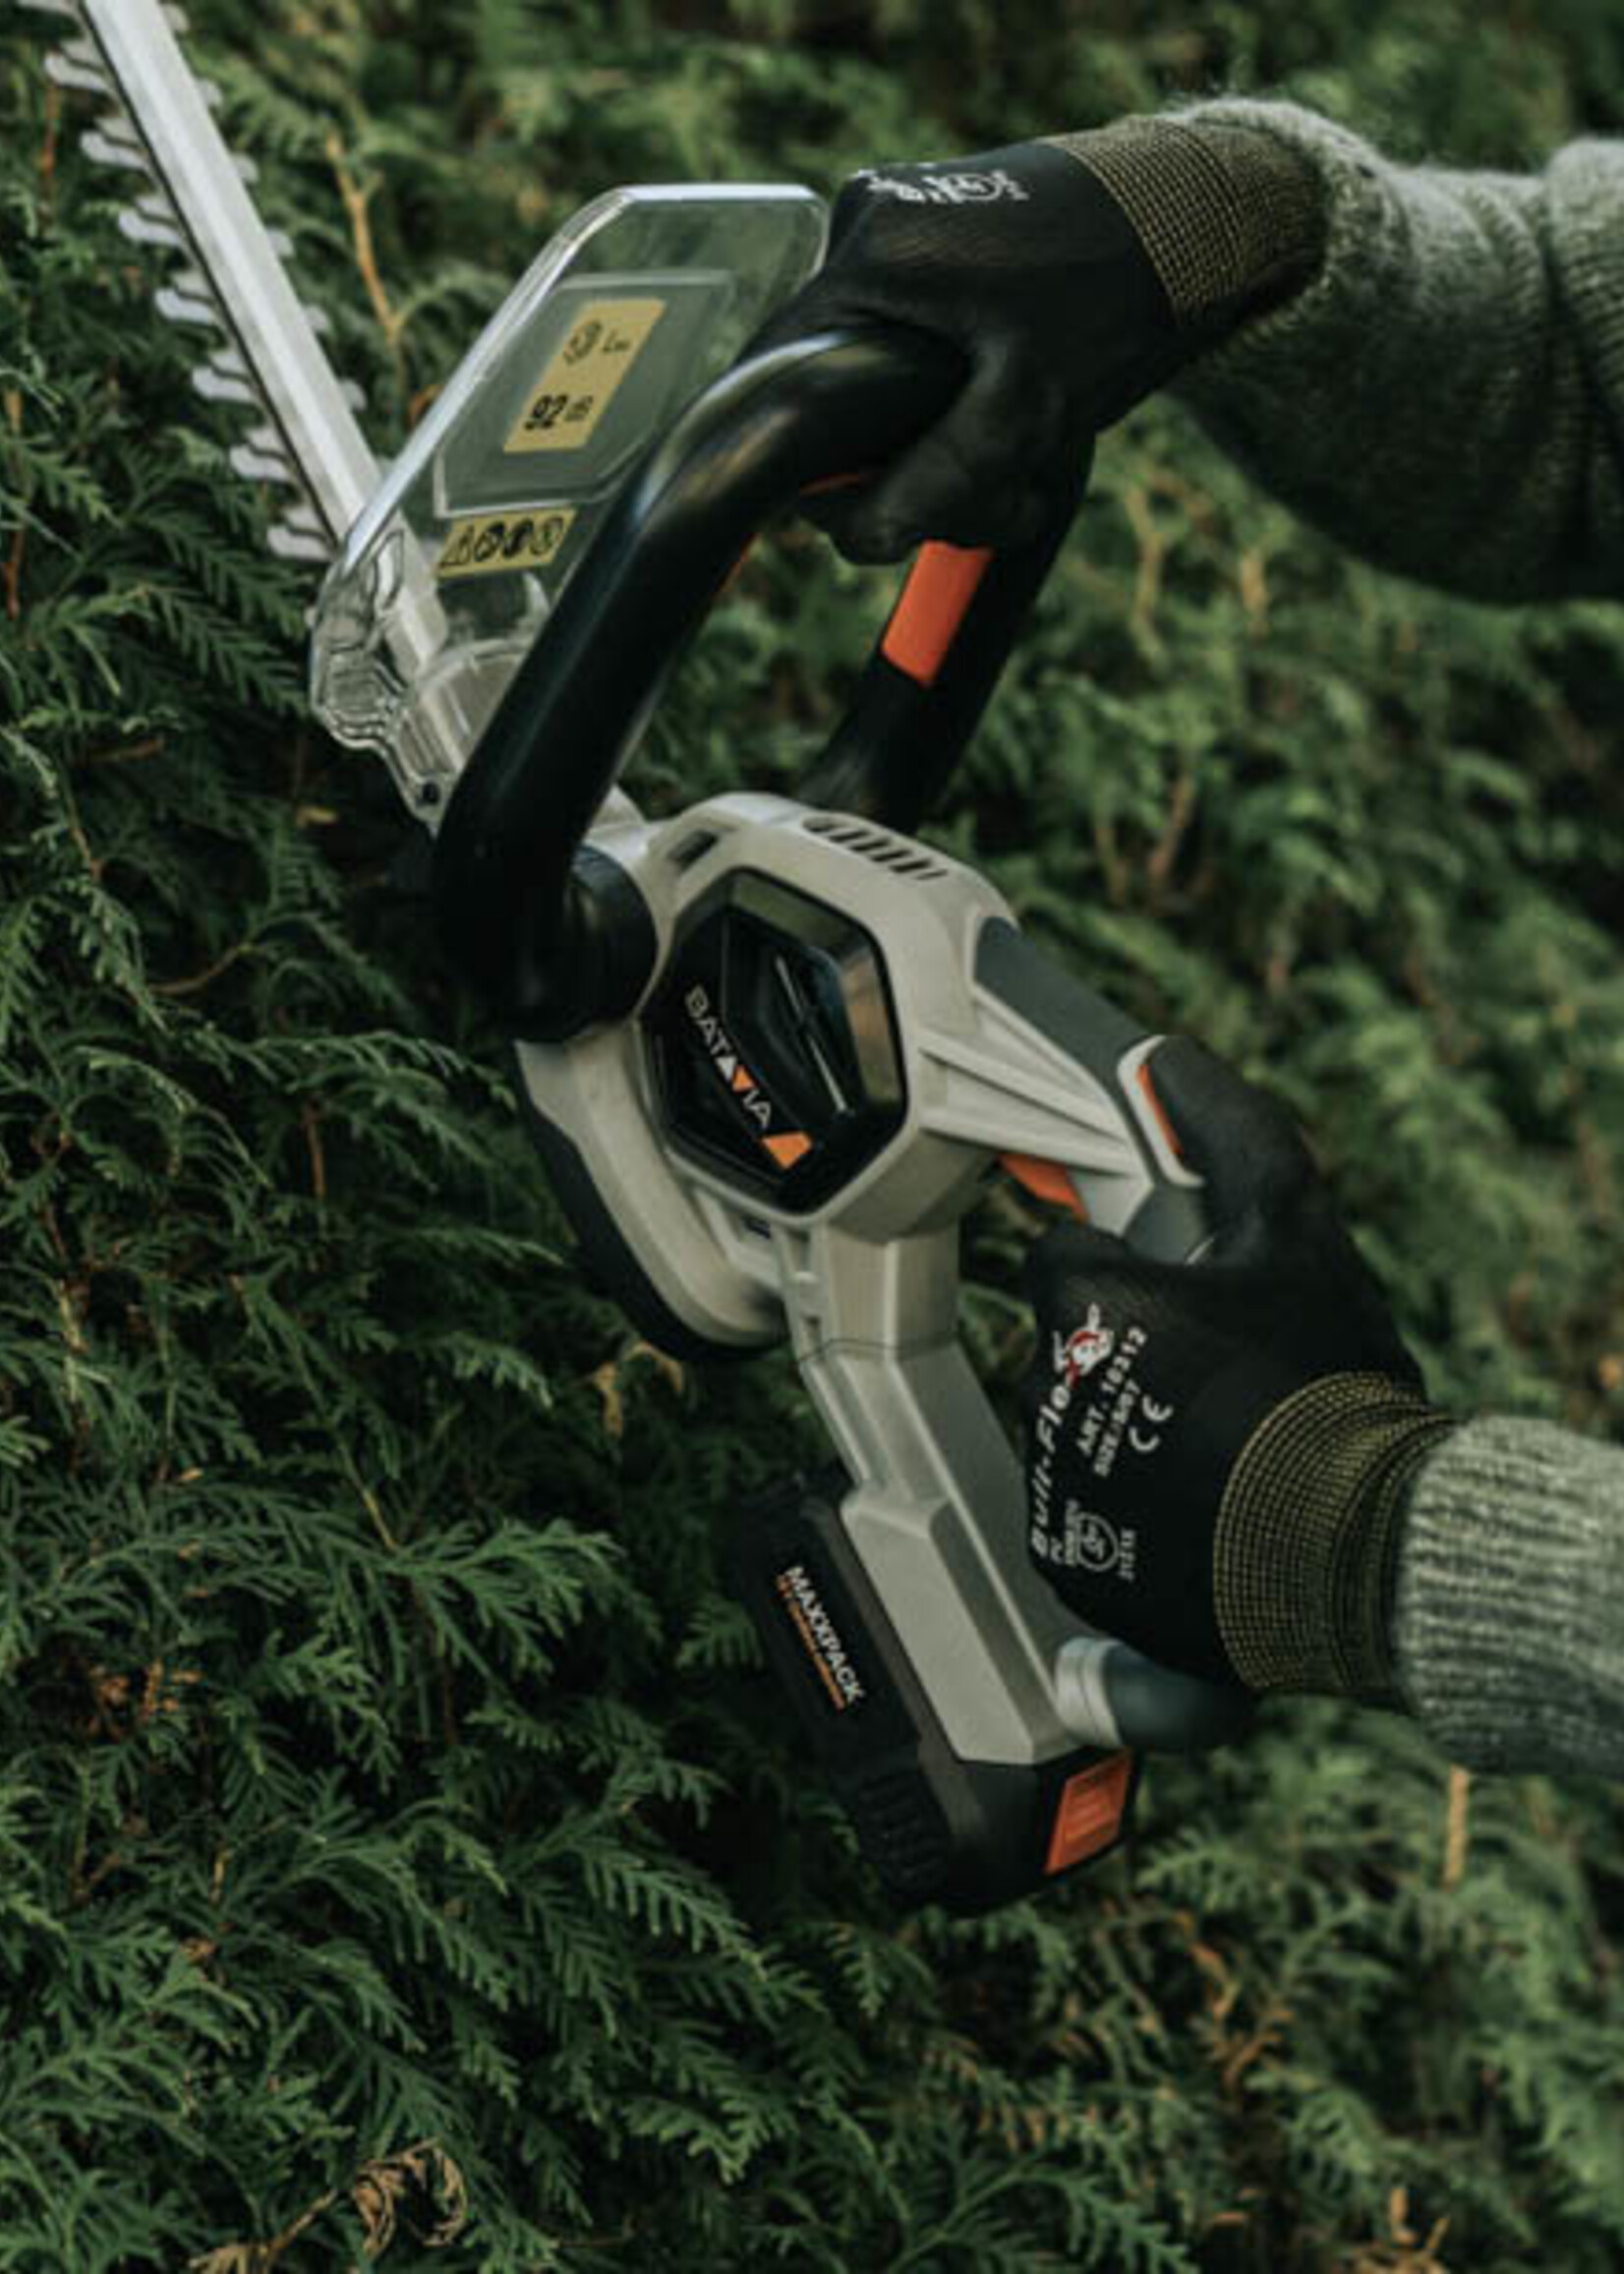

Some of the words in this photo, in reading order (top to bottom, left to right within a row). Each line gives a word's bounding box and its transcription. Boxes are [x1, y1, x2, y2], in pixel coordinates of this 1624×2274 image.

[524, 393, 568, 431] 92
[684, 984, 772, 1130] BATAVIA
[783, 1564, 865, 1704] MAXXPACK
